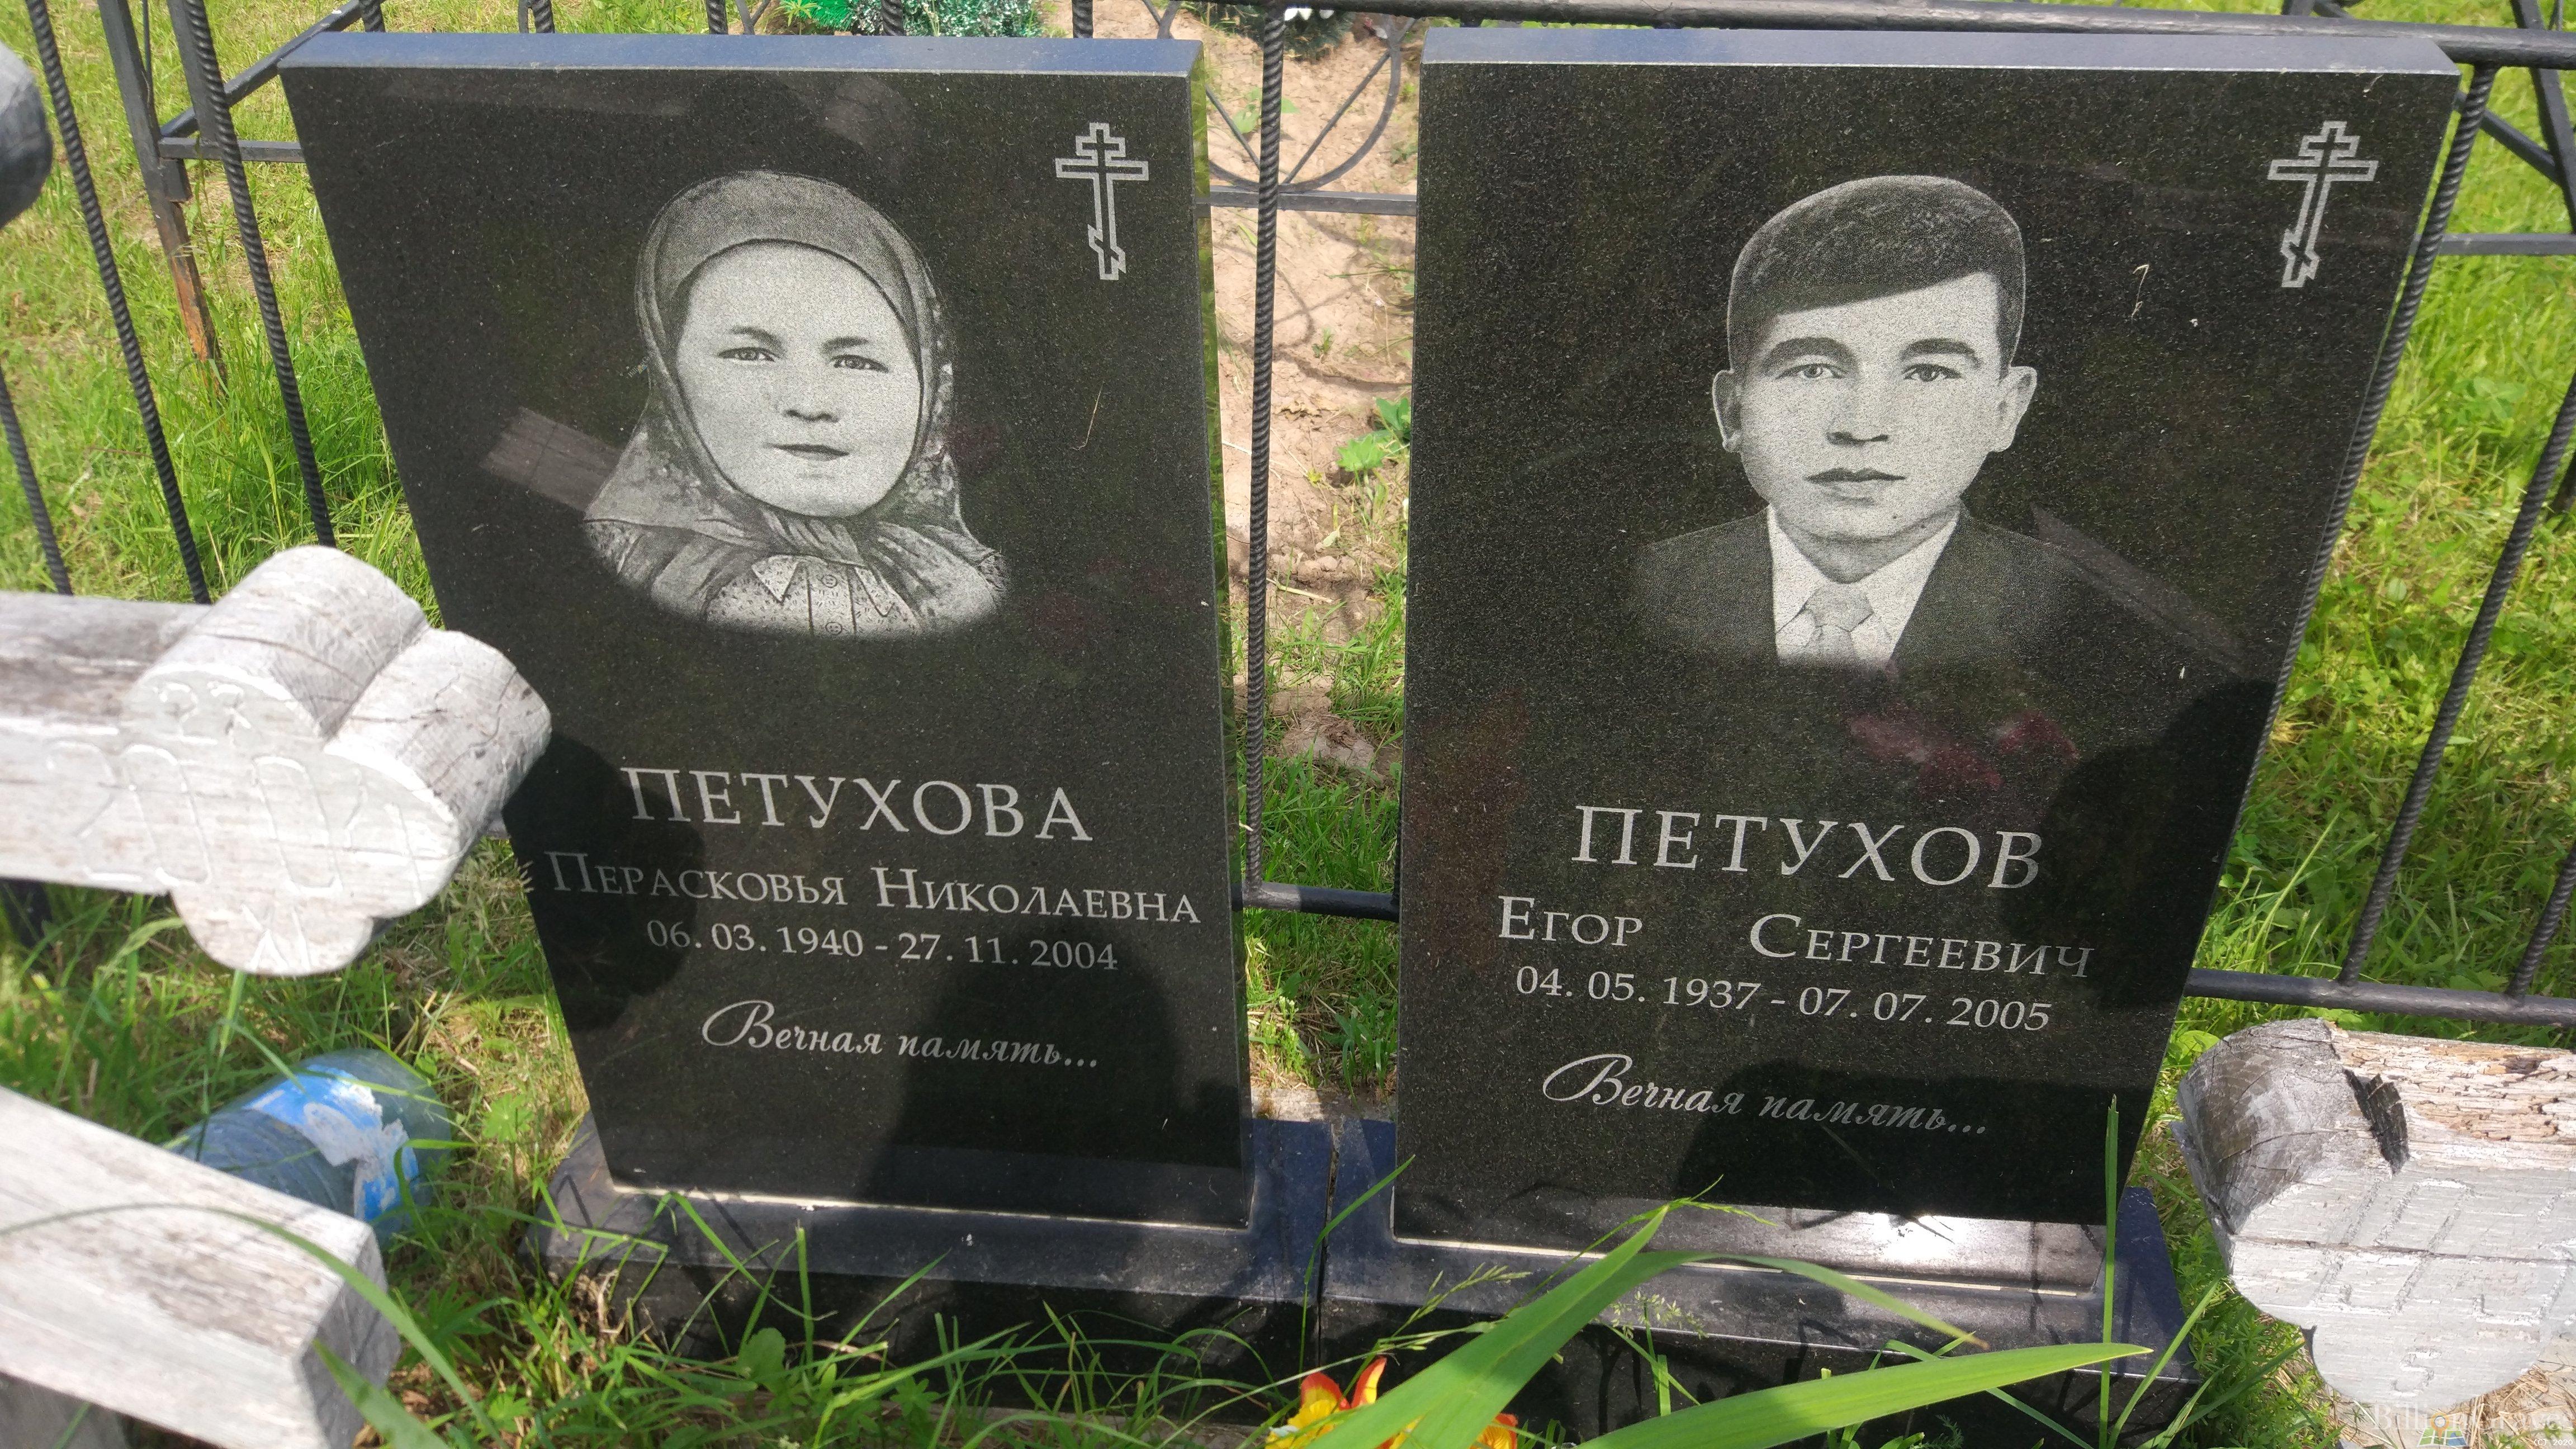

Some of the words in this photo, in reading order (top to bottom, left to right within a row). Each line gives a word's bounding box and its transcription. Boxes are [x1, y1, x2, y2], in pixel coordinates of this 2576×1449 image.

[620, 767, 1093, 841] ПЕТУХОВА
[1571, 804, 2042, 888] ПЕТУХОВ
[702, 1000, 883, 1054] Вечная
[1542, 1053, 1744, 1114] Вечная
